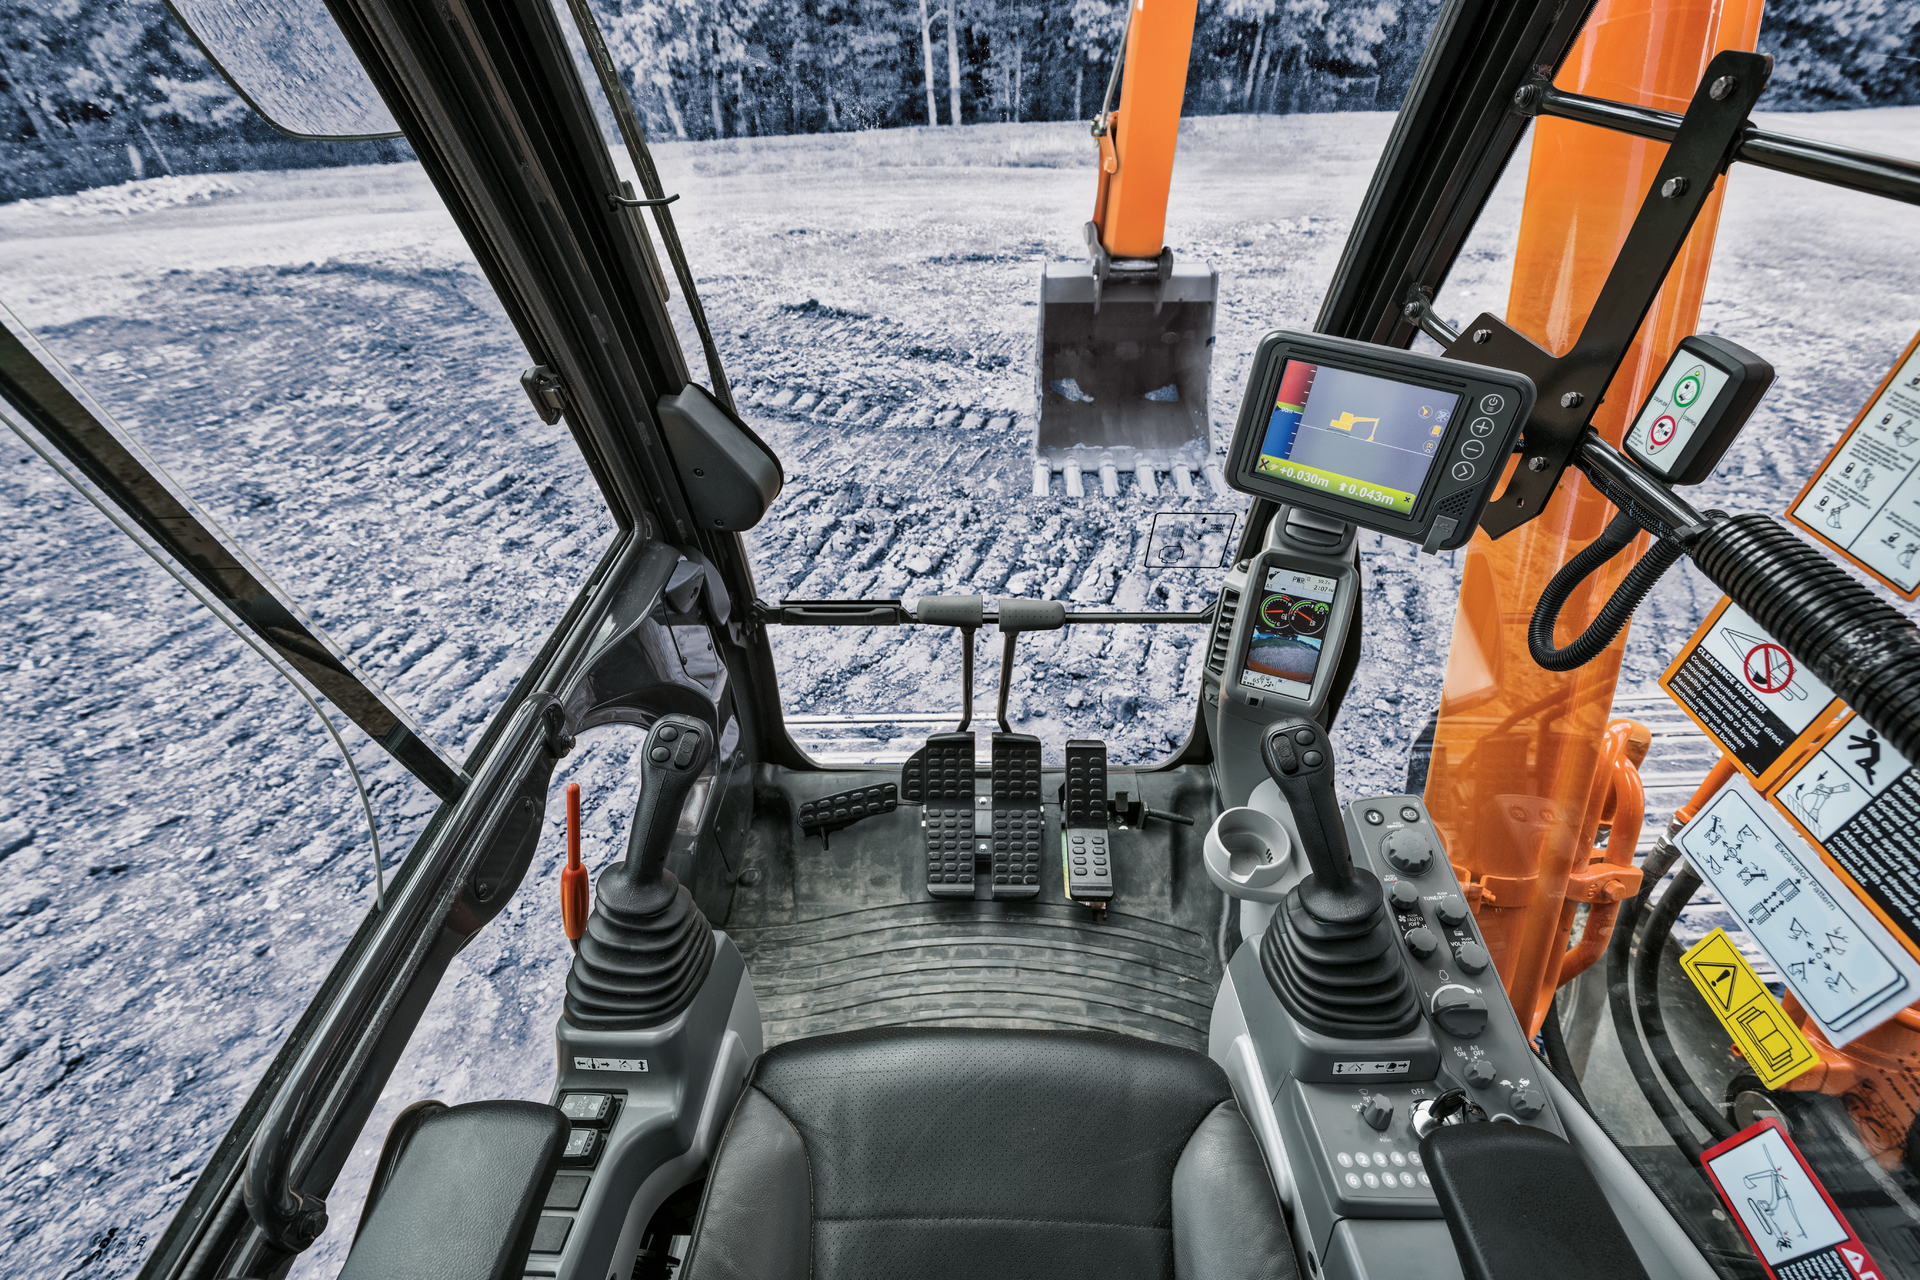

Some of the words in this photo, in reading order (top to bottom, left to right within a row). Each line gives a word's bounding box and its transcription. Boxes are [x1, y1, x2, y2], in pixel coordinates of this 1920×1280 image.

[1683, 415, 1697, 427] CONTROL
[1280, 466, 1329, 487] +0.030m
[1348, 484, 1394, 505] 0.043m
[1685, 662, 1710, 686] mounted
[1708, 684, 1743, 719] attachments
[1741, 717, 1761, 736] could
[1691, 655, 1712, 677] Coupler
[1711, 676, 1738, 701] mounted
[1735, 699, 1749, 712] and
[1747, 710, 1765, 728] some
[1763, 725, 1785, 746] direct
[1697, 647, 1736, 685] CLEARANCE
[1735, 682, 1768, 714] HAZARD!
[1669, 682, 1699, 713] attachment,
[1698, 711, 1710, 723] cab
[1708, 722, 1721, 734] and
[1719, 732, 1737, 753] boom.
[1674, 675, 1697, 699] Maintain
[1695, 698, 1722, 725] clearance
[1721, 722, 1746, 749] between
[1680, 668, 1703, 692] possibly
[1702, 689, 1724, 711] contact
[1722, 710, 1734, 722] cab
[1733, 720, 1742, 729] or
[1740, 727, 1759, 748] boom.
[1866, 806, 1884, 822] flat
[1880, 820, 1896, 833] on
[1875, 798, 1907, 827] locked
[1902, 825, 1916, 837] to
[1881, 792, 1918, 822] ground
[1825, 842, 1868, 886] movement.
[1832, 836, 1865, 867] contact
[1861, 865, 1881, 885] with
[1849, 820, 1864, 835] try
[1861, 833, 1873, 844] to
[1870, 842, 1902, 871] uncurl
[1857, 813, 1883, 838] While
[1879, 838, 1920, 875] applying
[1774, 842, 1809, 881] Excavator
[1808, 880, 1836, 911] Pattern
[1840, 830, 1889, 876] Attachment
[1884, 875, 1919, 906] should
[1342, 1156, 1348, 1164] 1
[1360, 1155, 1367, 1164] 2
[1378, 1155, 1385, 1163] 3
[1395, 1155, 1402, 1163] 4
[1413, 1155, 1420, 1163] 5
[1350, 1176, 1357, 1185] 6
[1368, 1175, 1374, 1184] 7
[1385, 1175, 1394, 1184] 8
[1404, 1175, 1412, 1184] 9
[1802, 1259, 1816, 1277] the
[1816, 1255, 1833, 1277] with
[1822, 1252, 1838, 1273] can
